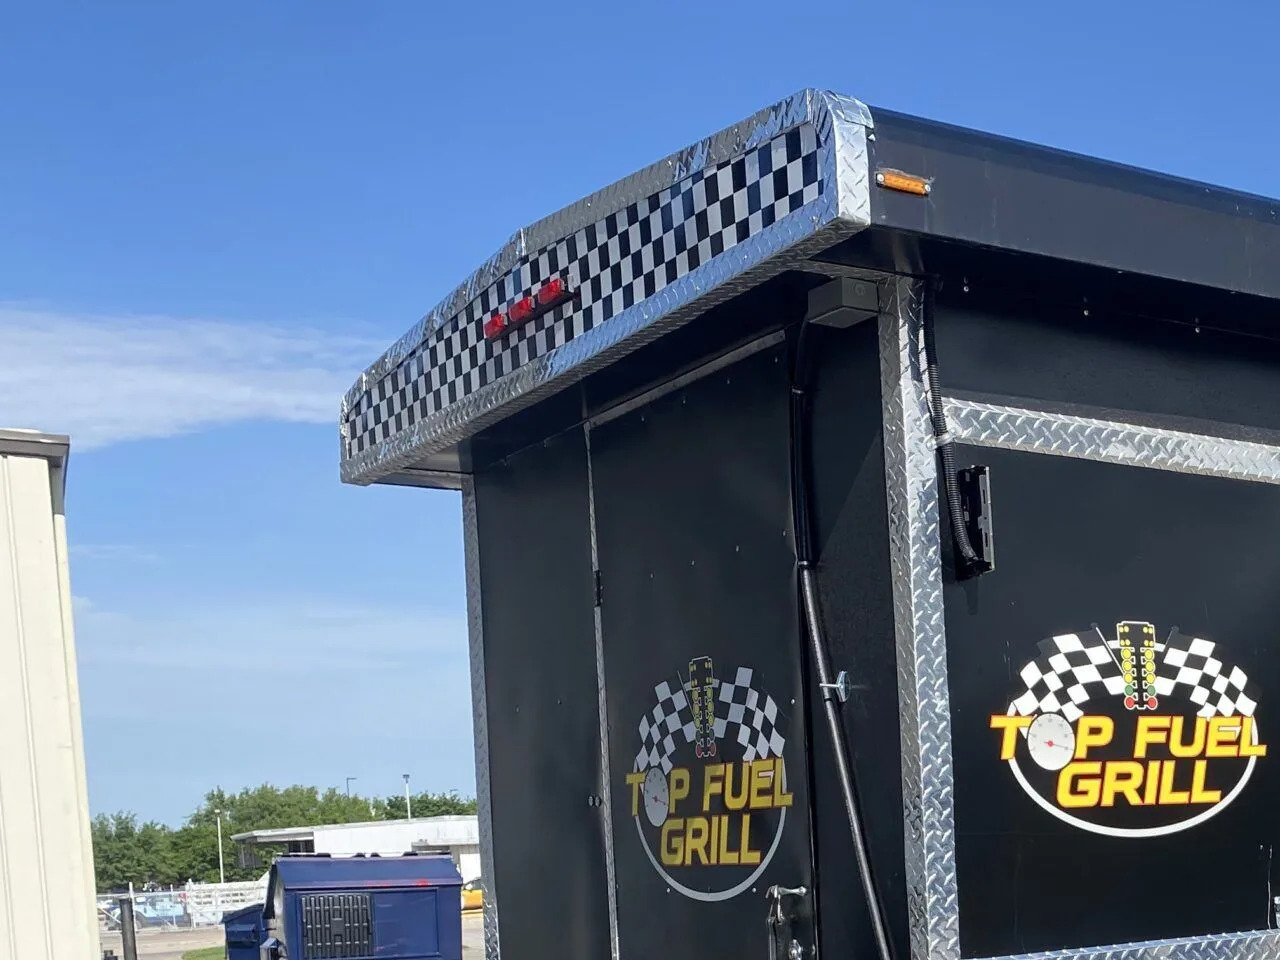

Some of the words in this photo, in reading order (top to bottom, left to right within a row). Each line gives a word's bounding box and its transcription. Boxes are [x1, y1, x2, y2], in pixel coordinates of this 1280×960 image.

[1133, 714, 1268, 759] FUEL
[702, 757, 794, 813] FUEL
[1056, 759, 1222, 809] GRILL
[659, 813, 762, 867] GRILL
